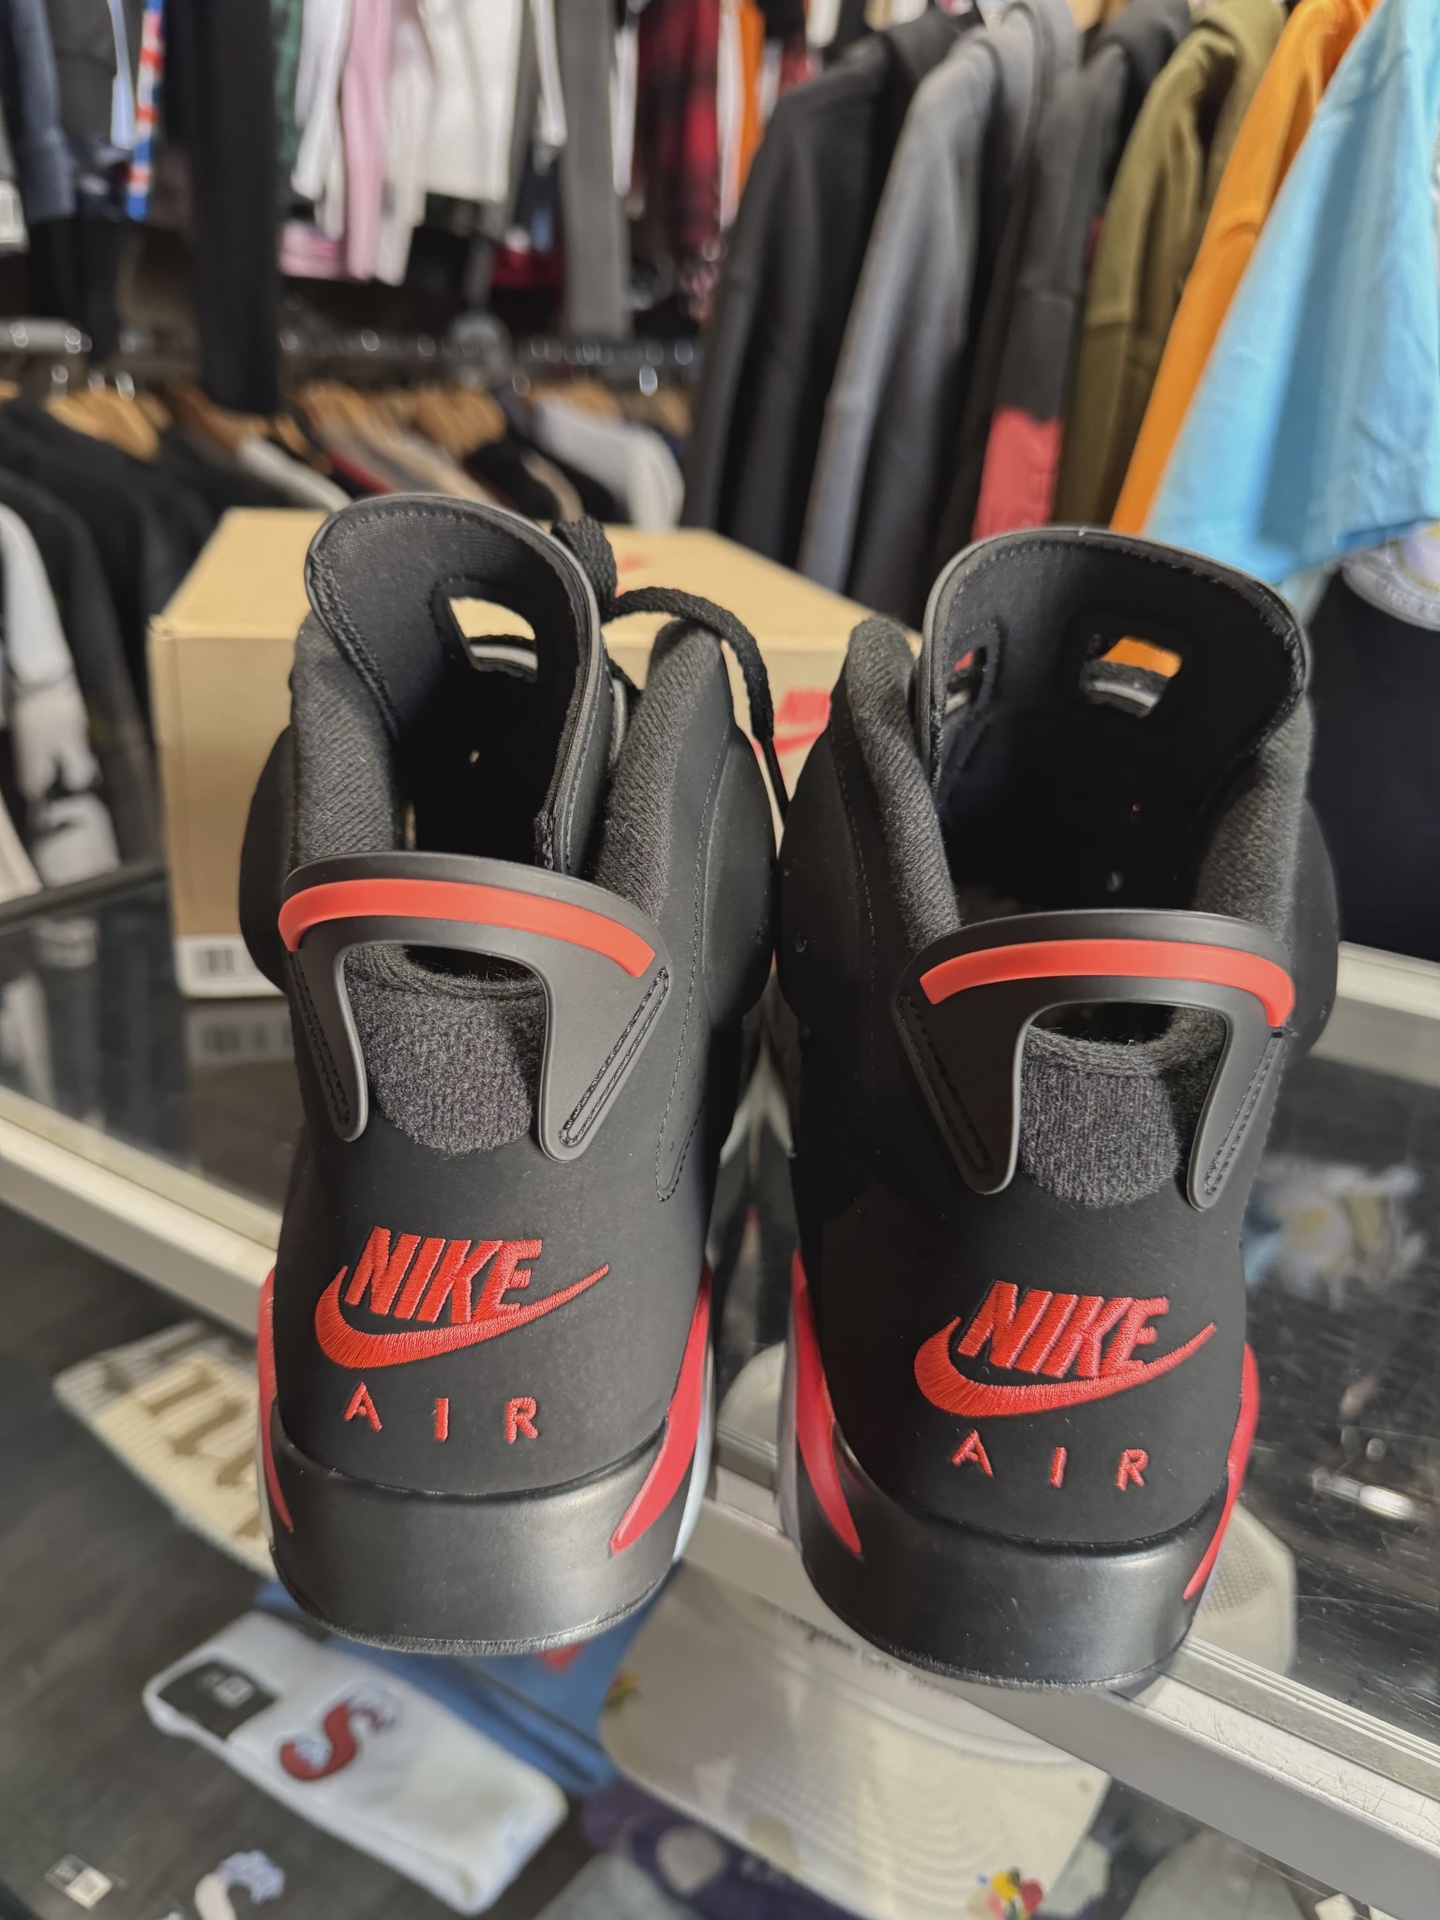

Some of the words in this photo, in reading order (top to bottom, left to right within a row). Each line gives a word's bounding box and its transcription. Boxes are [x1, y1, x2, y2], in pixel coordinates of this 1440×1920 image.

[344, 1226, 543, 1326] NIKE
[956, 1279, 1170, 1379] NIKE
[343, 1381, 539, 1444] AIR
[951, 1429, 1149, 1491] AIR
